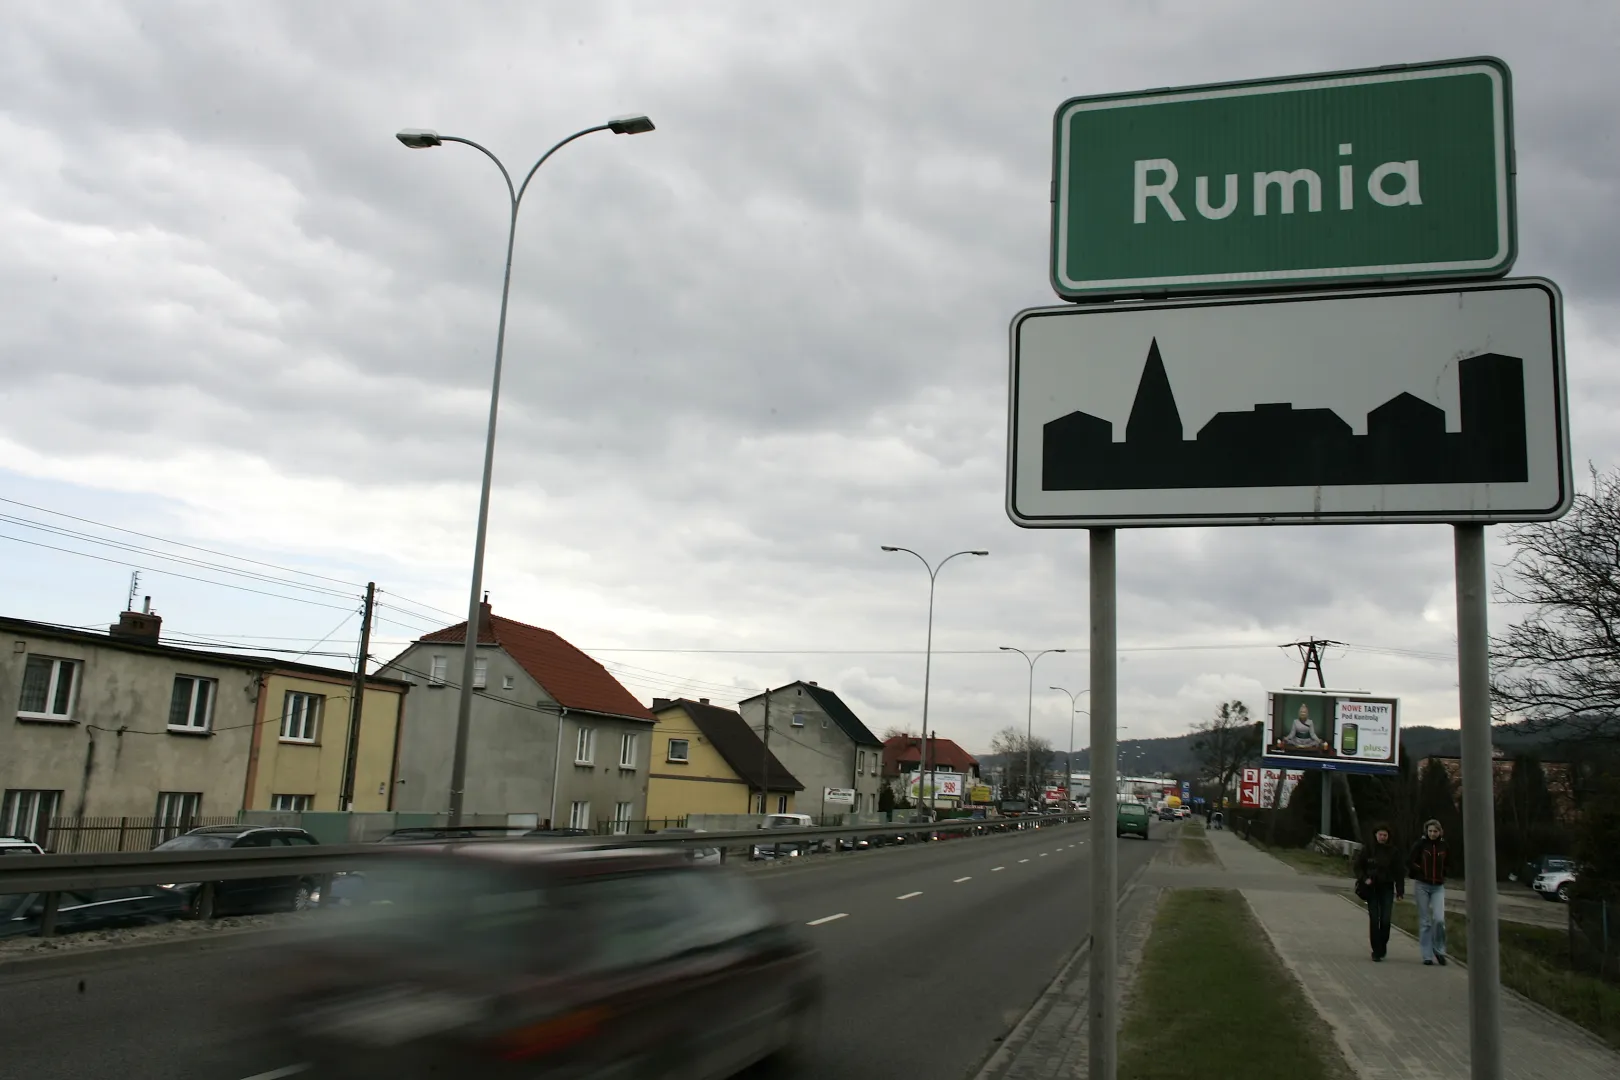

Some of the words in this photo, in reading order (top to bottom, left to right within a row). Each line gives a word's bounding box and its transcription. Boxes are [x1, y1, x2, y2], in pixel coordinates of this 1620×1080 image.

[1132, 143, 1424, 224] Rumia
[1342, 704, 1362, 713] NOWE
[1364, 705, 1389, 714] TARYFY
[1363, 744, 1382, 752] plus
